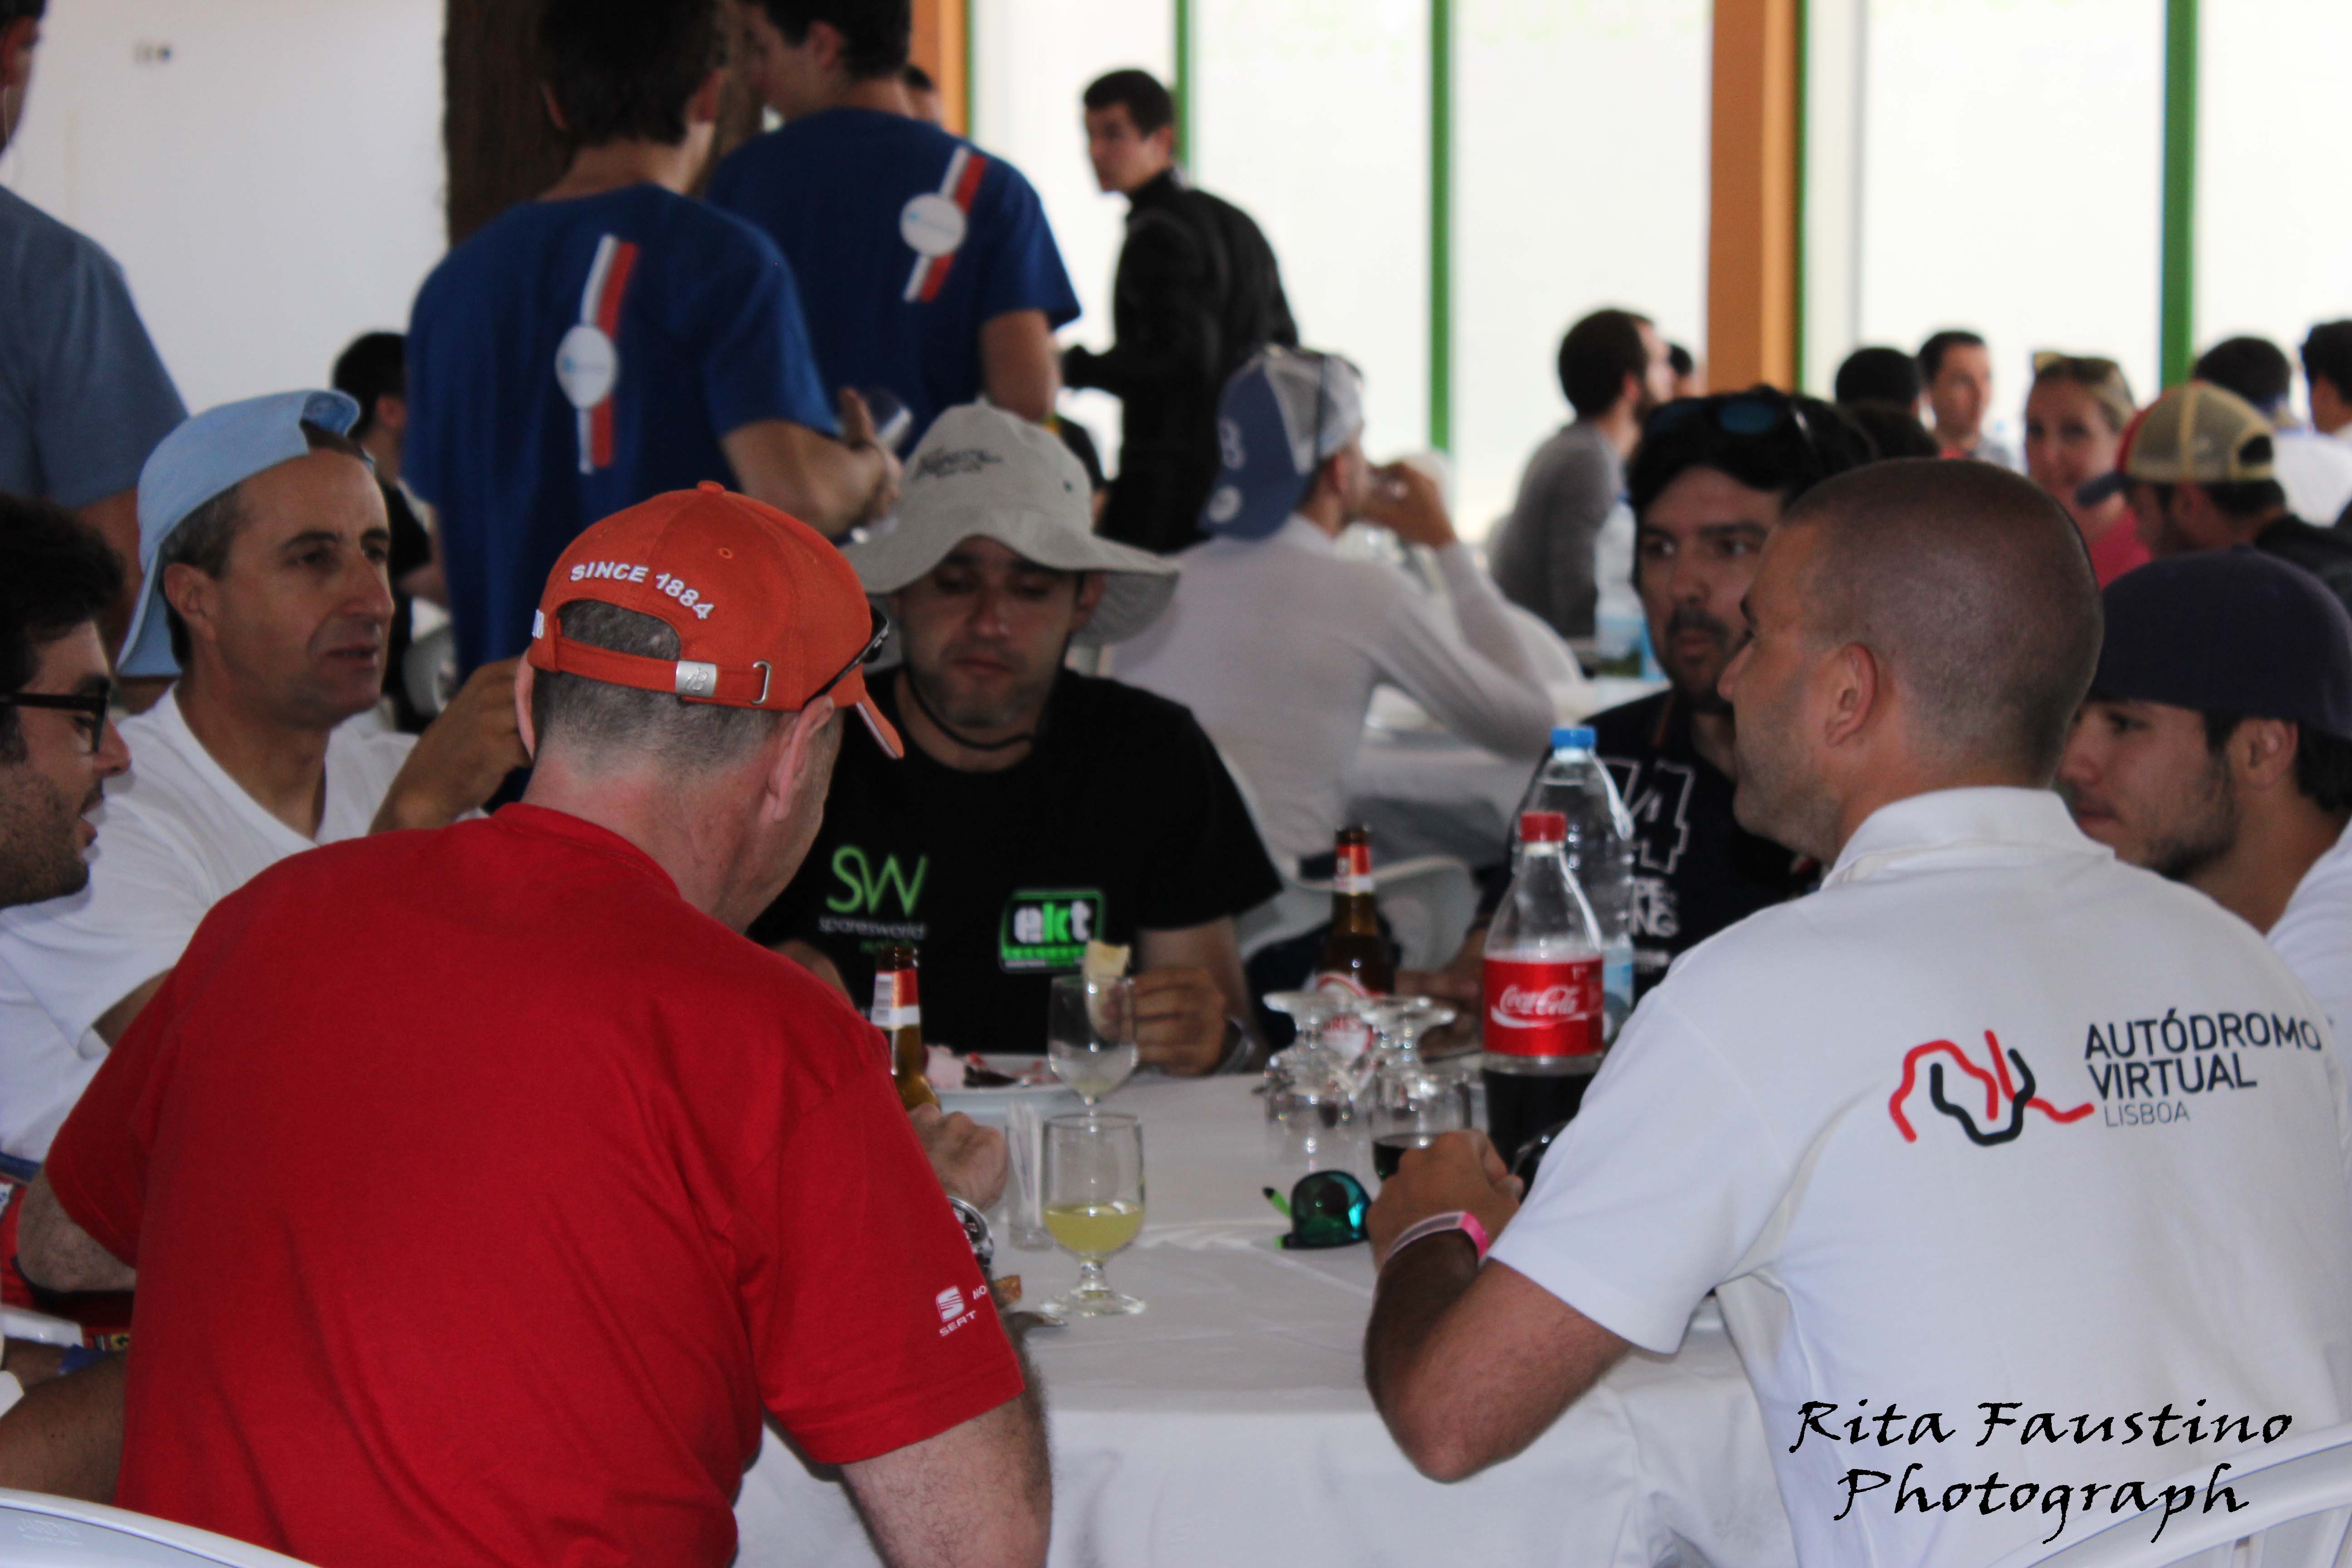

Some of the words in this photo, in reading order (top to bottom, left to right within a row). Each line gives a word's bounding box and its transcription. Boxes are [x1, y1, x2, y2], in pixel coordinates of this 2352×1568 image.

[570, 561, 649, 583] SINCE
[655, 573, 715, 619] 1884
[825, 845, 928, 916] SW
[1014, 900, 1091, 944] ekt
[2084, 1008, 2322, 1059] AUTÓDROMO
[2088, 1053, 2258, 1100] VIRTUAL
[2104, 1100, 2190, 1127] LISBOA
[939, 1310, 976, 1337] SEAT
